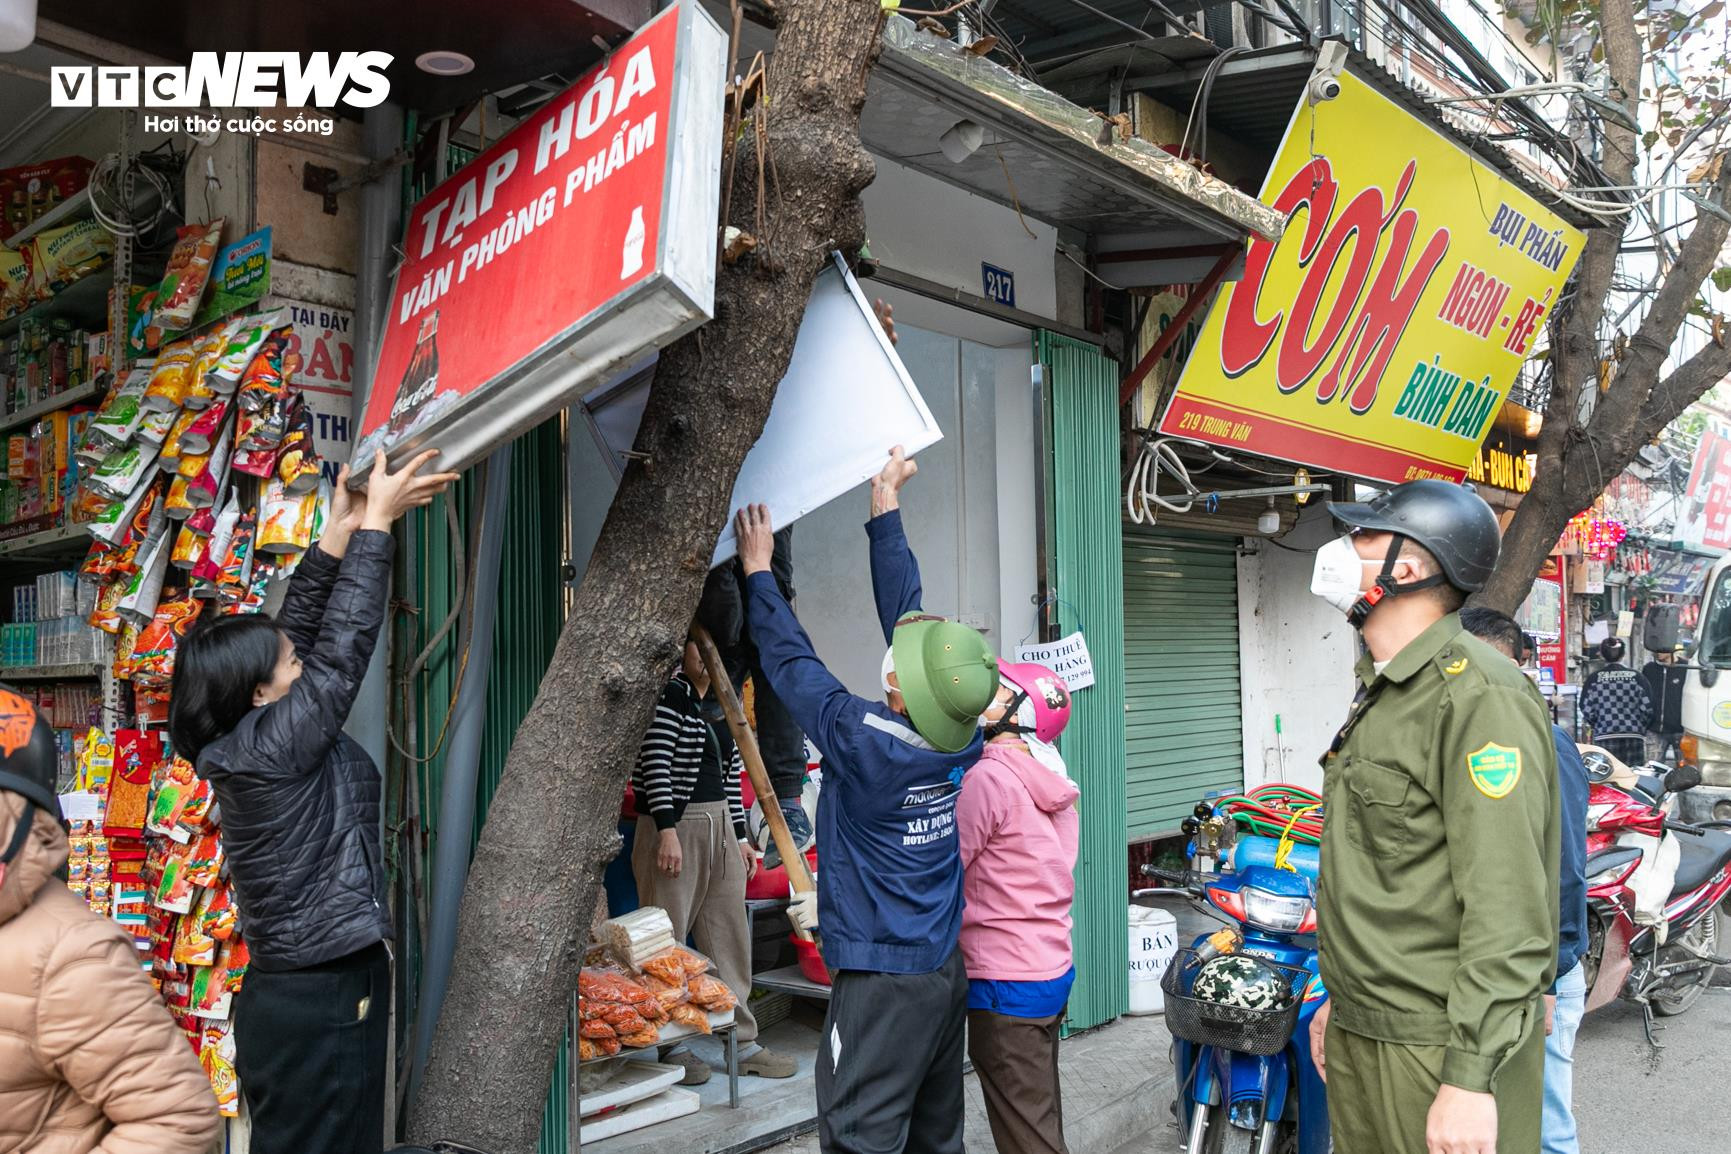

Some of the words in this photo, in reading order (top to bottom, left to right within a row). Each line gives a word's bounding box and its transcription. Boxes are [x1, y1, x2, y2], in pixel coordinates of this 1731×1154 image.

[420, 148, 519, 260] TẠP
[533, 45, 656, 176] HÓA
[400, 260, 455, 325] VĂN
[458, 186, 557, 284] PHÒNG
[563, 111, 657, 208] PHẨM
[1488, 202, 1526, 248] BỤI
[1519, 221, 1568, 272] PHẤN
[987, 271, 1011, 301] 217
[1220, 155, 1451, 415] CƠM
[290, 306, 315, 327] TẠI
[320, 311, 350, 333] ĐÂY
[1437, 261, 1511, 339] NGON
[1503, 287, 1553, 356] RẺ
[1392, 354, 1461, 428] BÌNH
[1443, 374, 1500, 441] DÂN
[1179, 411, 1202, 431] 219
[1200, 415, 1232, 438] TRUNG
[1230, 422, 1253, 442] VĂN
[1490, 441, 1514, 490] BÚN
[1022, 650, 1050, 662] CHO
[1053, 638, 1082, 658] THUÊ
[907, 818, 930, 834] XÂY
[931, 811, 952, 829] DỰNG
[903, 831, 939, 846] HOTLINE:
[1142, 931, 1173, 951] BÁN
[1241, 947, 1276, 959] ONDA
[1128, 957, 1161, 971] RƯỢU
